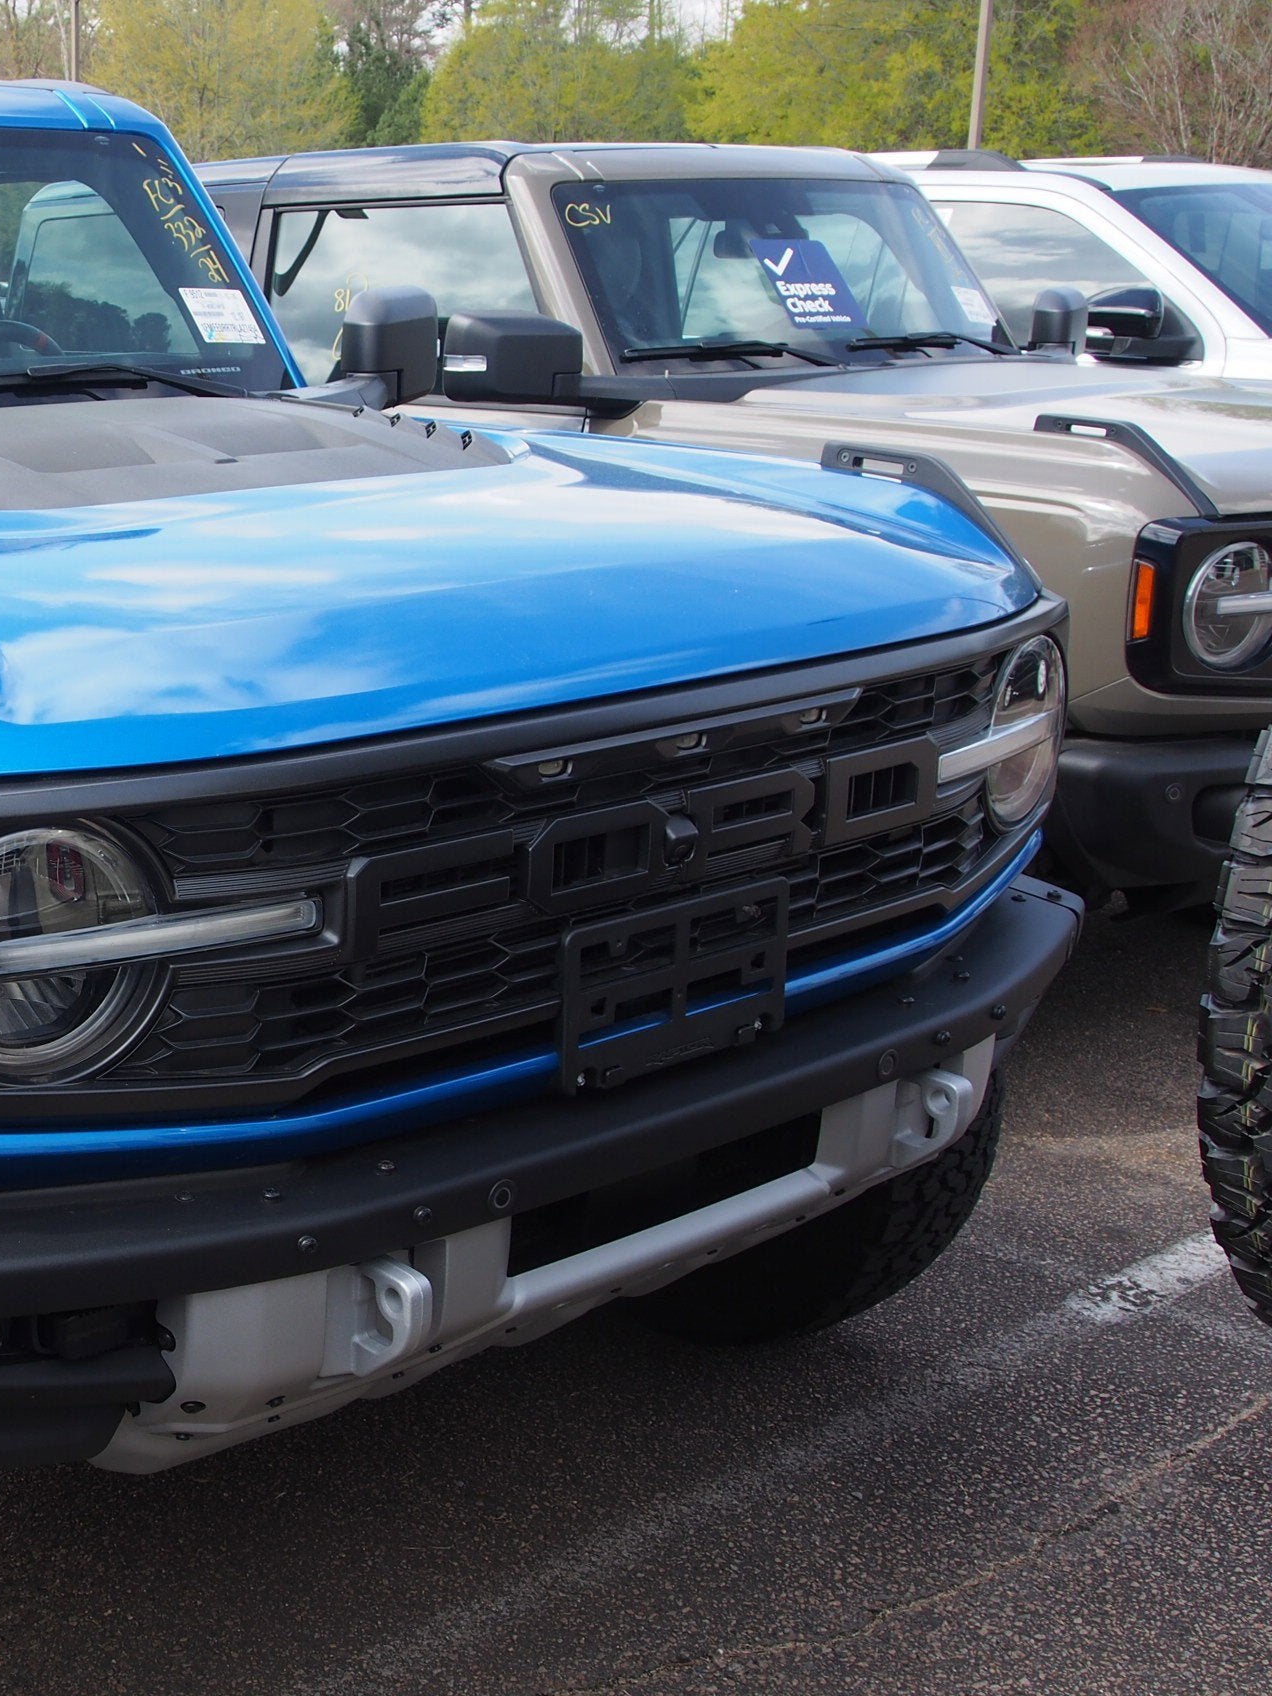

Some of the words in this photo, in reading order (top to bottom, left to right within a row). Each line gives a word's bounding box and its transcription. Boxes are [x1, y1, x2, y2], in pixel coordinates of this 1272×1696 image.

[564, 203, 611, 227] CSV
[164, 216, 206, 251] 332
[776, 281, 836, 298] Express
[786, 297, 834, 313] Check
[347, 734, 937, 965] FORD
